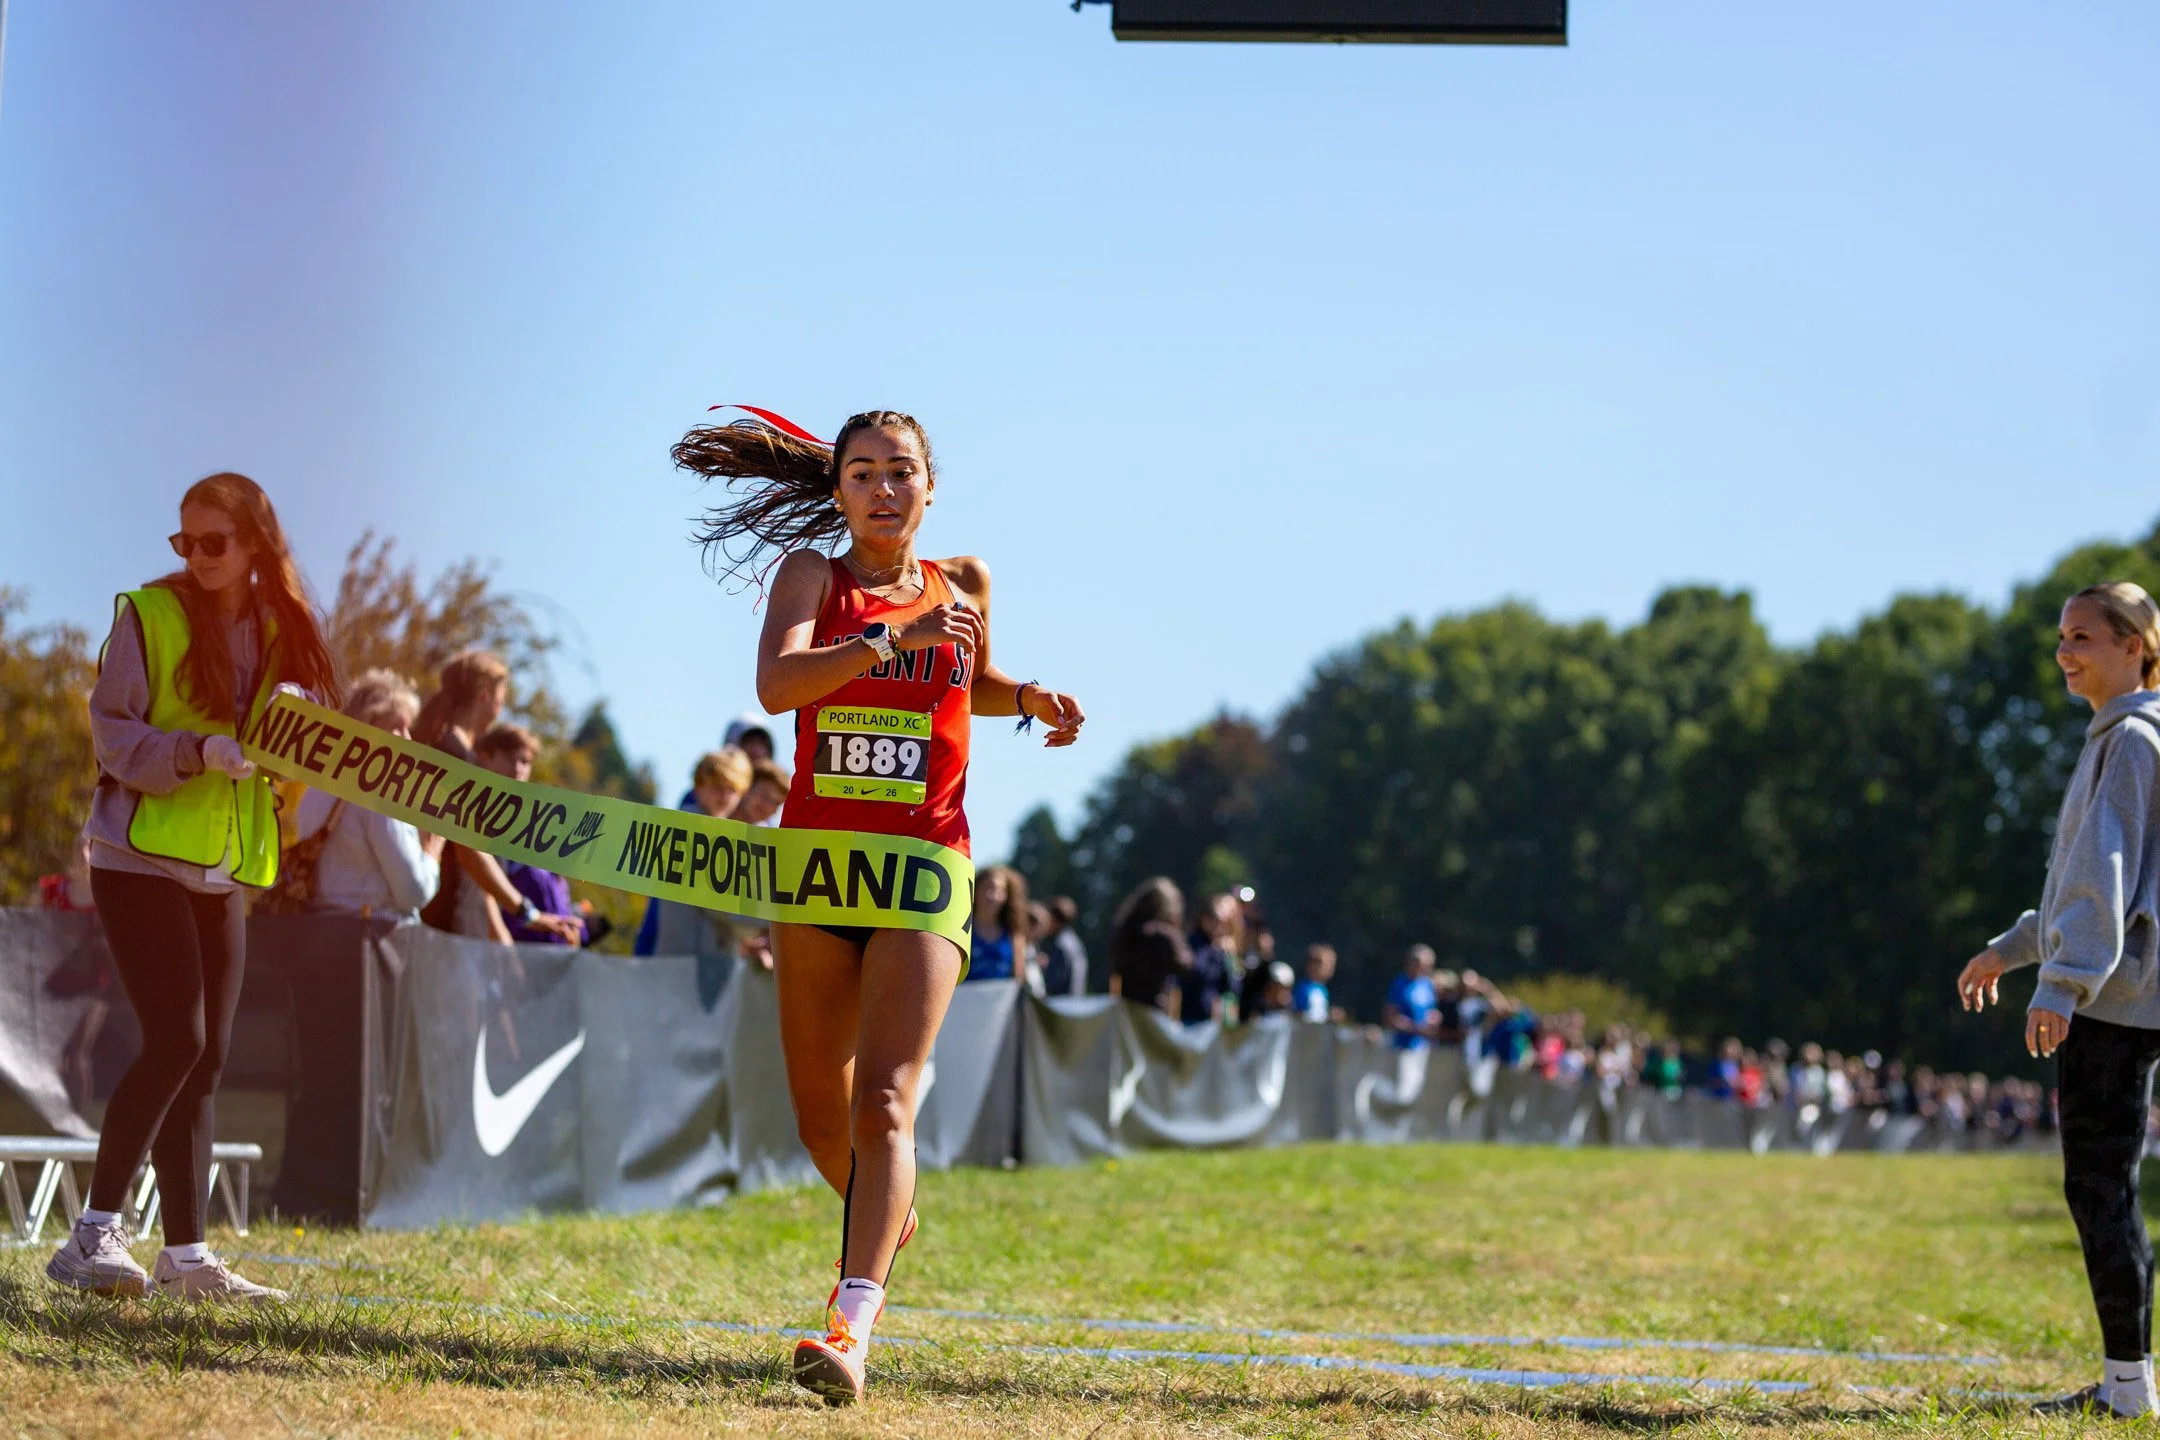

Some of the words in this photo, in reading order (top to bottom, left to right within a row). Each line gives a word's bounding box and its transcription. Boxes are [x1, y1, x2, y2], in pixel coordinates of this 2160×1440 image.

[818, 634, 941, 683] UNT
[829, 711, 899, 728] PORTLAND
[903, 717, 920, 730] XC
[828, 735, 922, 777] 1889
[248, 706, 344, 774] NIKE
[331, 736, 523, 838] PORTLAND
[509, 800, 567, 853] XC
[573, 811, 605, 838] RUN
[616, 820, 688, 884] NIKE
[688, 832, 953, 914] PORTLAND
[843, 785, 854, 794] 20
[885, 788, 897, 797] 26
